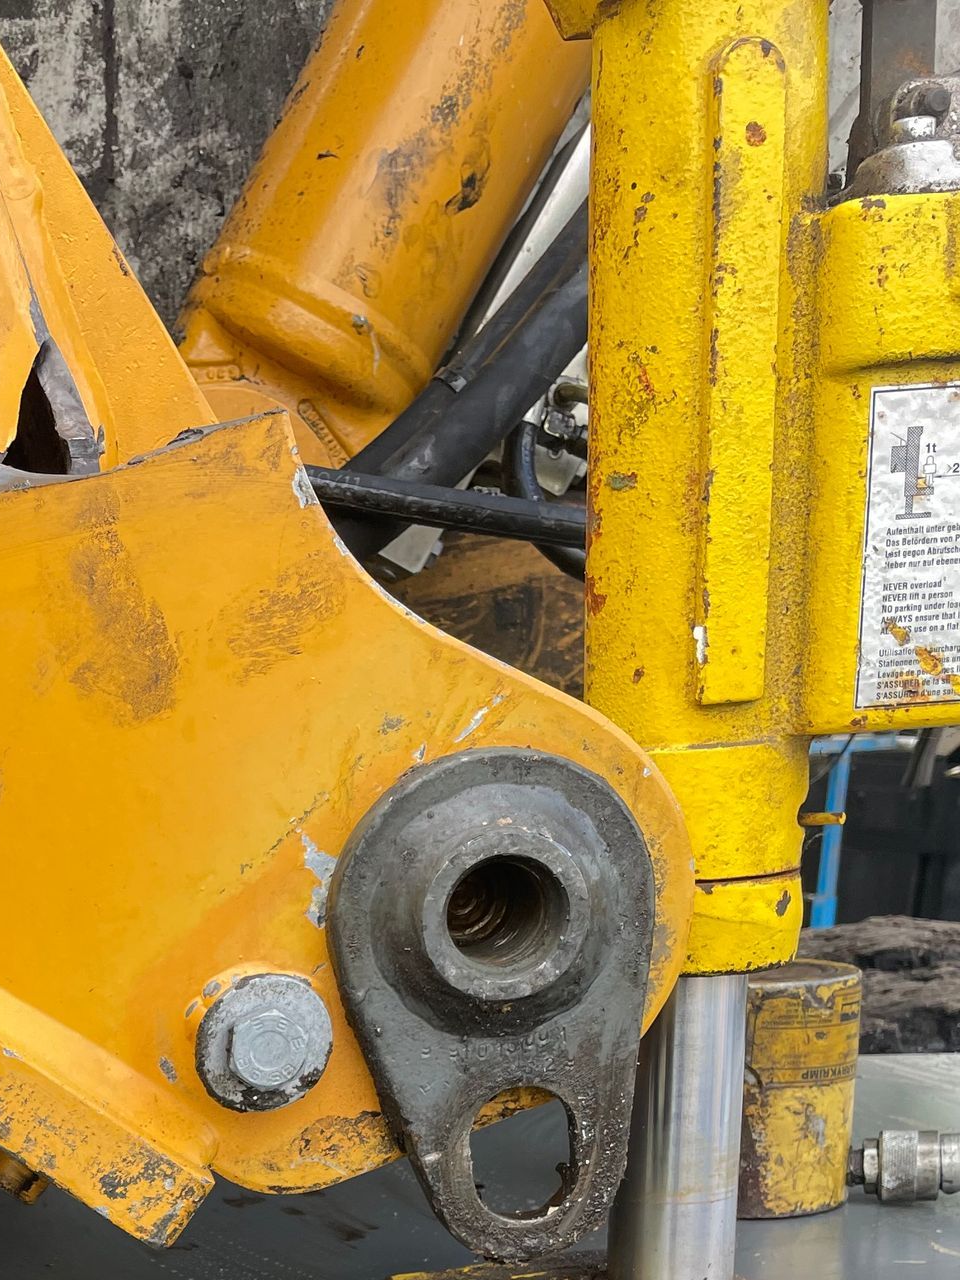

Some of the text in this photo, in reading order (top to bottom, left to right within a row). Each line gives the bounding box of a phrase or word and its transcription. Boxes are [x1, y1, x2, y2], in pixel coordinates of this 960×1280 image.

[886, 525, 924, 536] Aufenthalt
[926, 524, 945, 534] unter
[885, 538, 900, 548] Das
[902, 536, 938, 546] Befördern
[940, 535, 953, 543] von
[885, 549, 901, 559] Last
[908, 560, 921, 568] nur
[922, 558, 934, 567] auf
[882, 579, 942, 592] NEVER overload
[882, 592, 907, 603] NEVER
[909, 592, 920, 601] lift
[928, 591, 953, 601] person
[881, 604, 893, 614] NO
[894, 603, 922, 614] parking
[924, 602, 946, 611] under
[915, 614, 940, 623] ensure
[941, 611, 956, 620] that
[913, 625, 927, 633] use
[947, 622, 959, 631] flat
[877, 670, 904, 679] Levage
[905, 669, 915, 677] de
[921, 678, 931, 686] de
[932, 677, 940, 685] la
[920, 688, 941, 697] d'une
